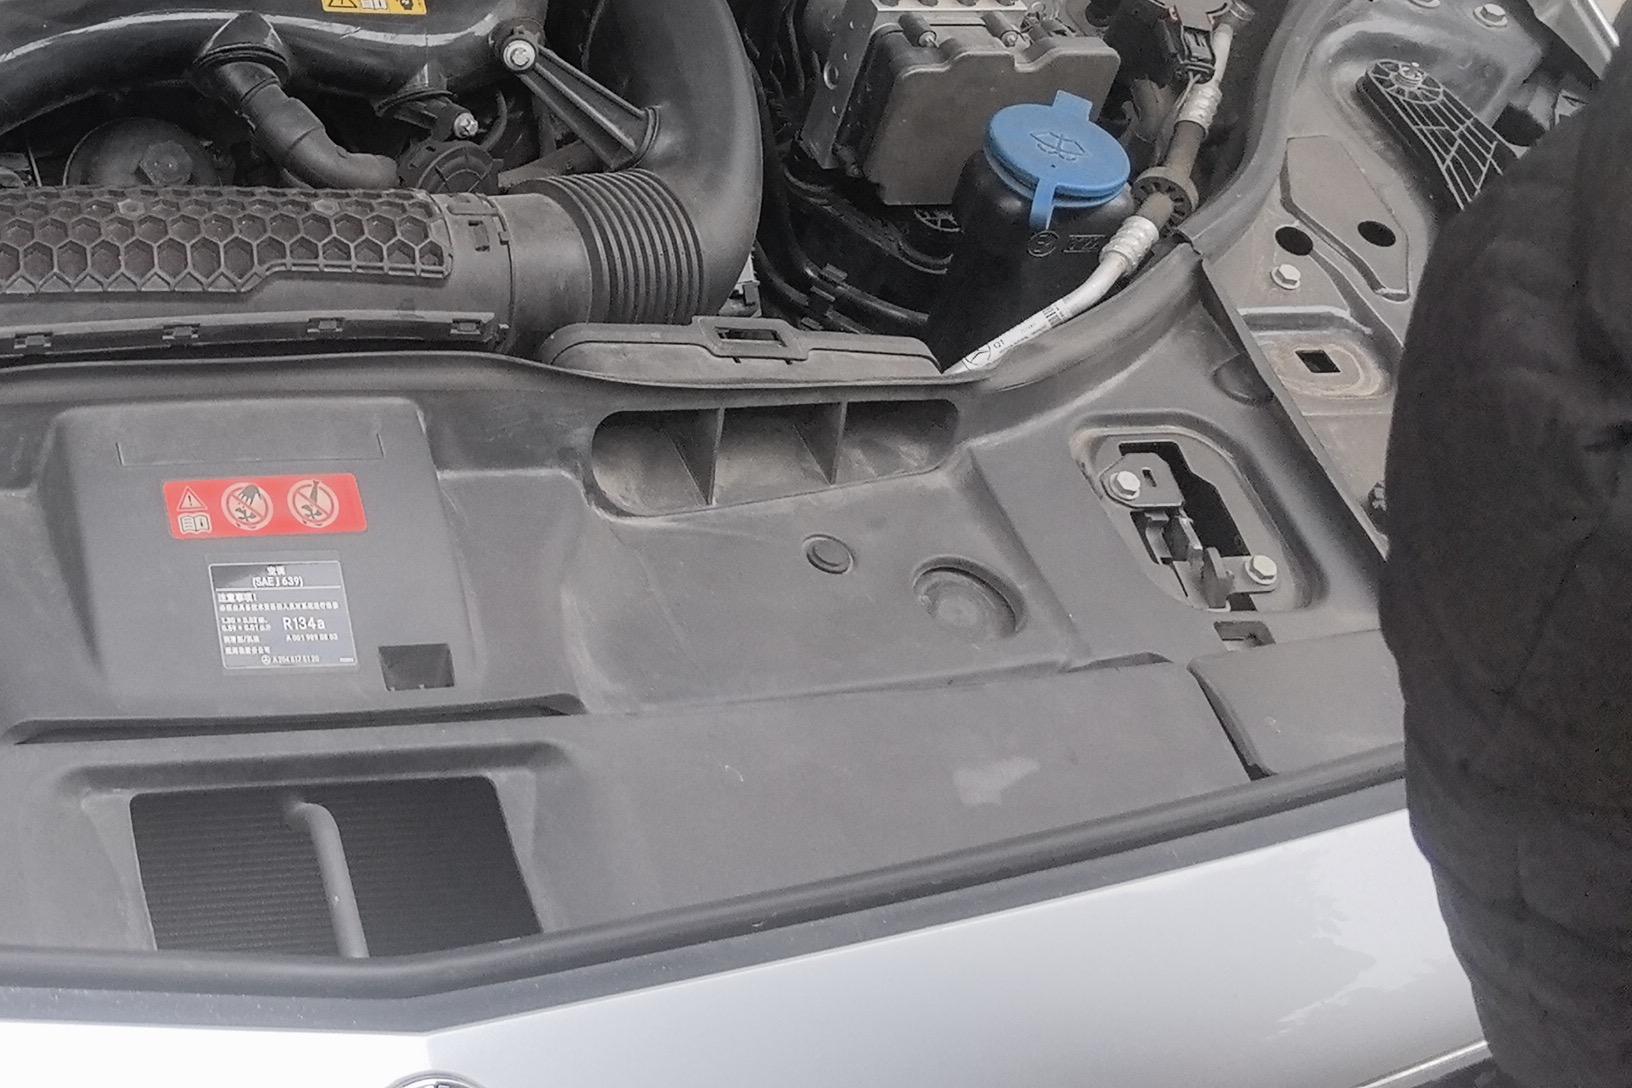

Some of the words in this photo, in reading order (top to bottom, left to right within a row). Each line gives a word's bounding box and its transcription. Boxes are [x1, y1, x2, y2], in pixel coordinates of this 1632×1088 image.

[252, 576, 275, 588] (SAE
[281, 575, 304, 587] 639)
[282, 616, 325, 630] R134a
